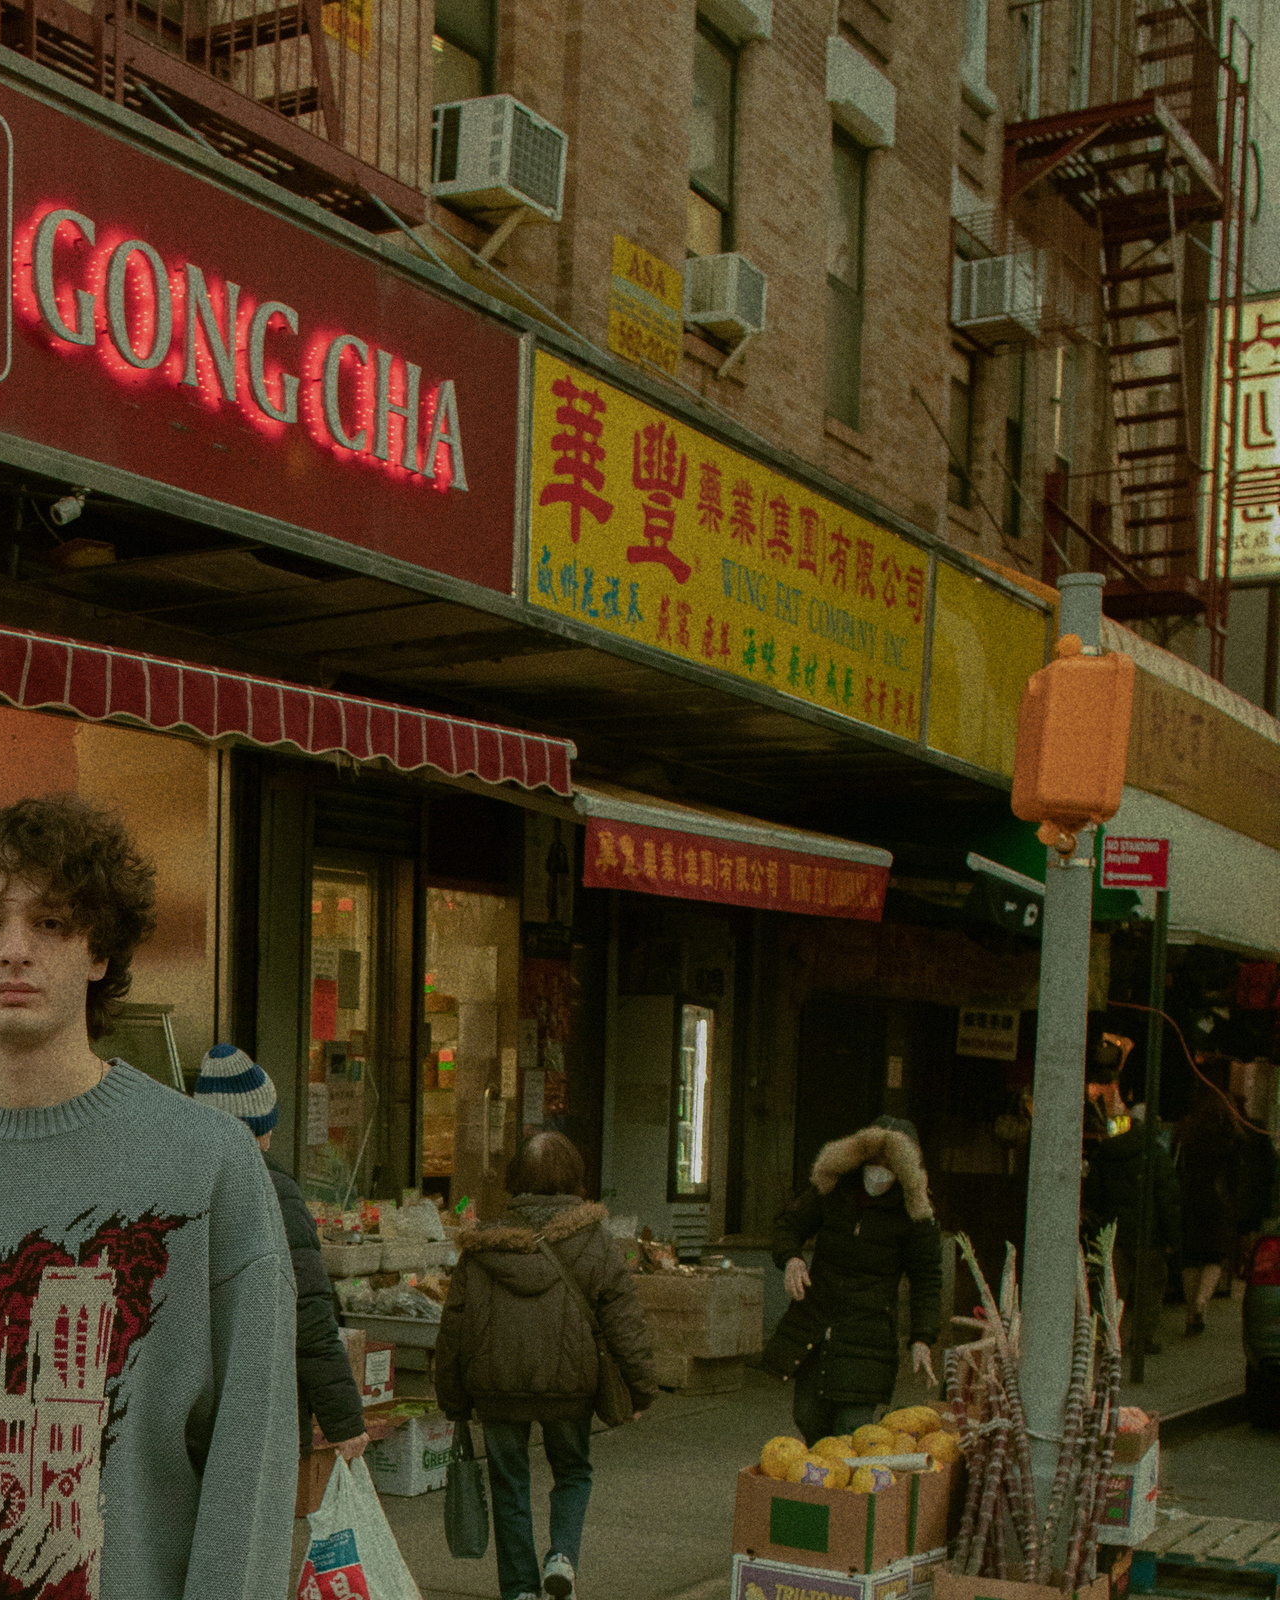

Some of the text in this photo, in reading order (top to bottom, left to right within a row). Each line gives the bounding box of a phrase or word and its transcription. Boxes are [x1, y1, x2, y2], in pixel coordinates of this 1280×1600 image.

[32, 209, 469, 492] GONG CHA
[721, 557, 768, 614] WING
[775, 581, 803, 625] FAT
[809, 599, 878, 660] COMPANY
[1106, 840, 1160, 853] NO STANDING
[422, 1449, 450, 1470] GREE
